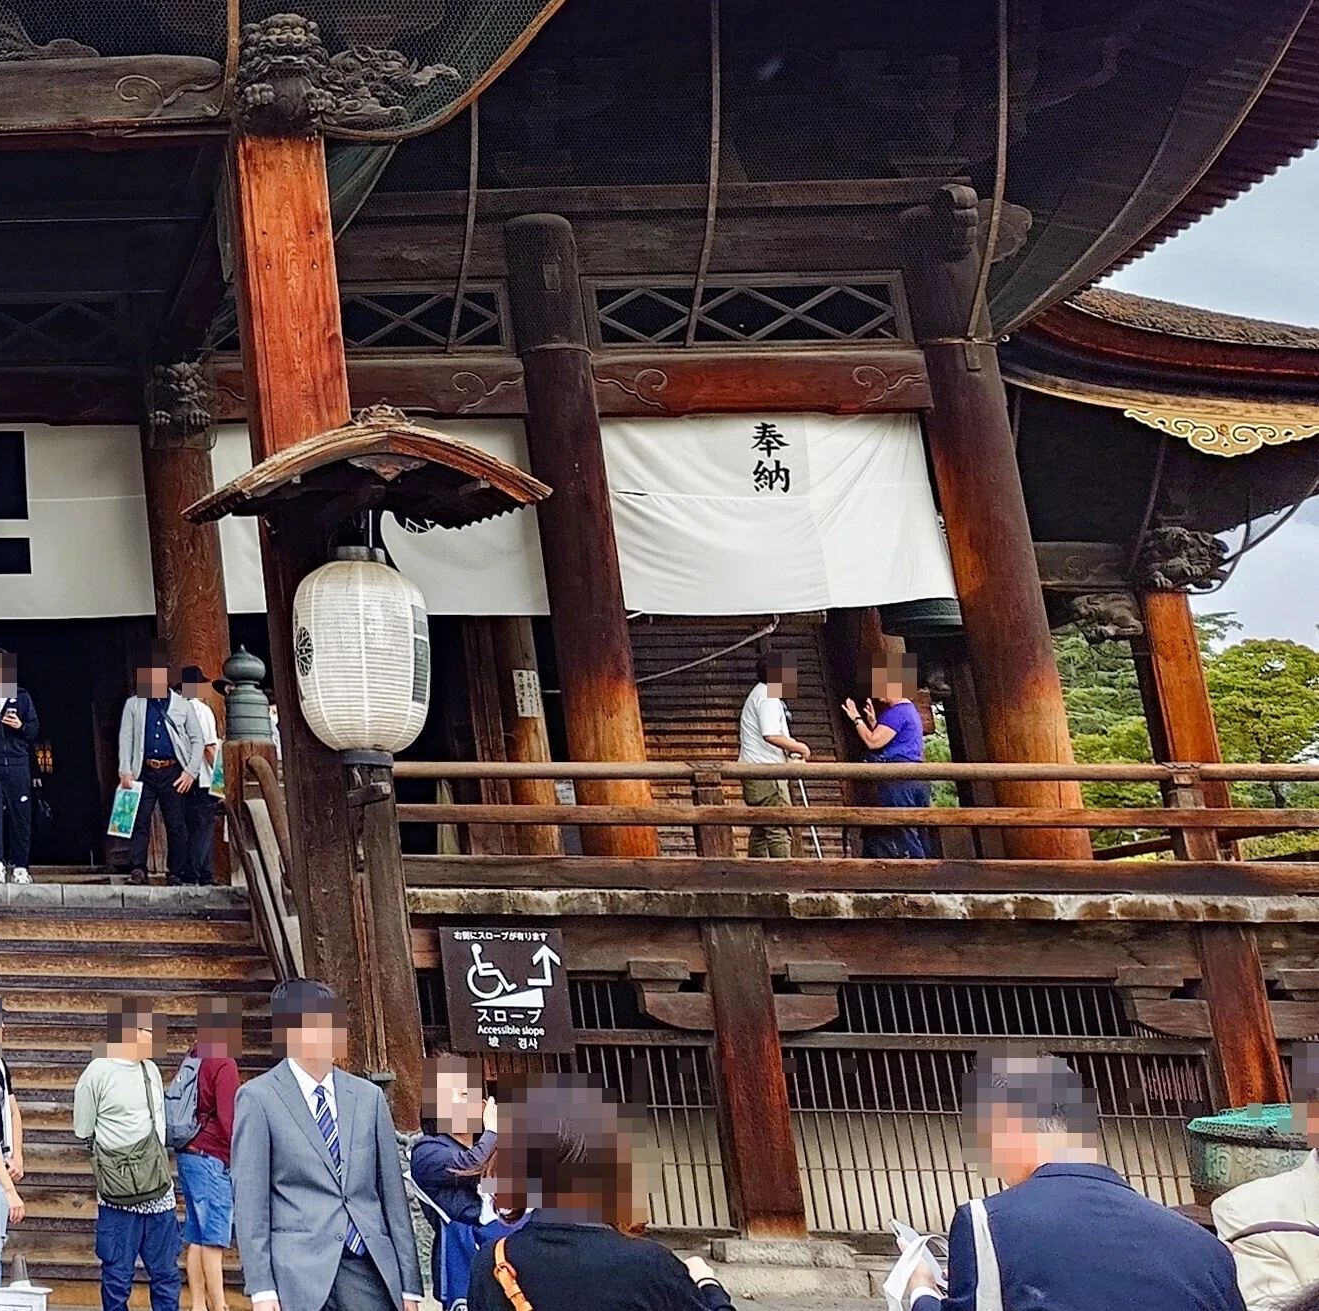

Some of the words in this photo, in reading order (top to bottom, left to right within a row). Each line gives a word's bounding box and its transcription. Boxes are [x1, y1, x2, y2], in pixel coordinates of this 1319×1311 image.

[751, 421, 790, 493] 奉納
[453, 931, 548, 942] 右側にスロープが有ります
[477, 1009, 542, 1024] スロープ
[477, 1024, 521, 1035] Accessible
[521, 1025, 545, 1037] slope
